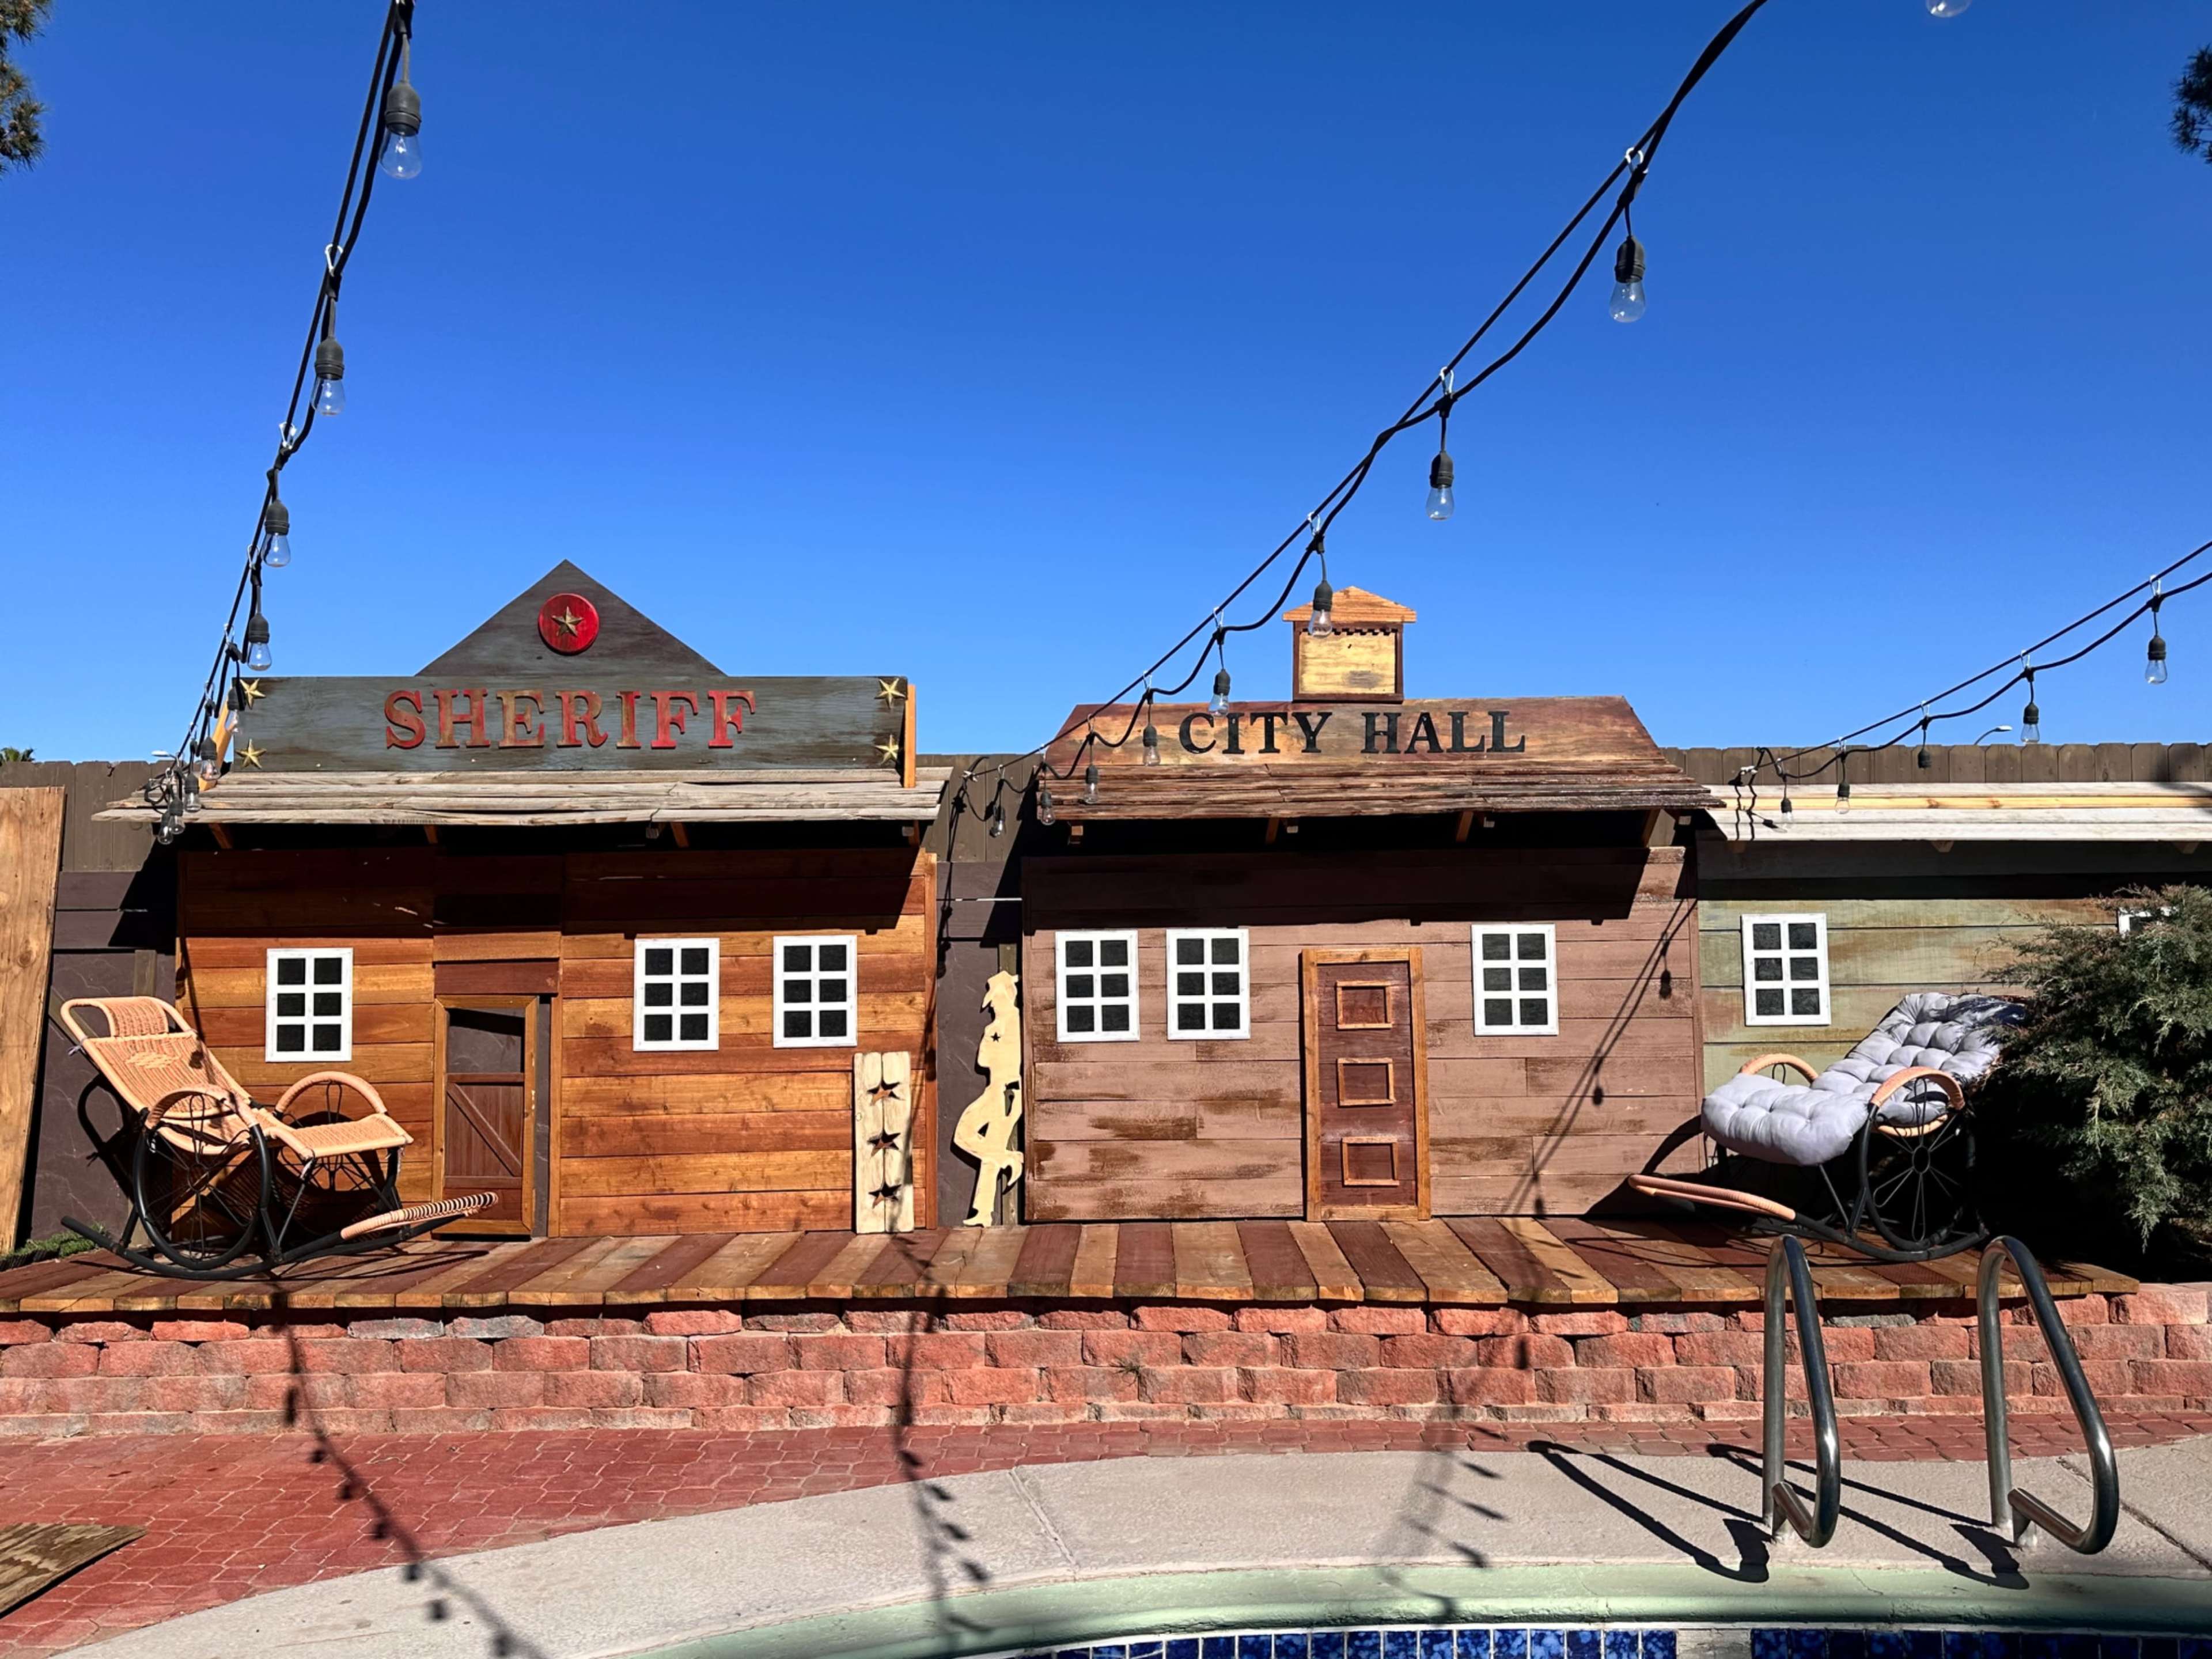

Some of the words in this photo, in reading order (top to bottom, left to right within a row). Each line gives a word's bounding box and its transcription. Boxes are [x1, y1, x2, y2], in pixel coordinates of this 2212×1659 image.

[384, 688, 755, 748] SHERIFF
[1179, 711, 1332, 754] CITY
[1361, 711, 1525, 753] HALL
